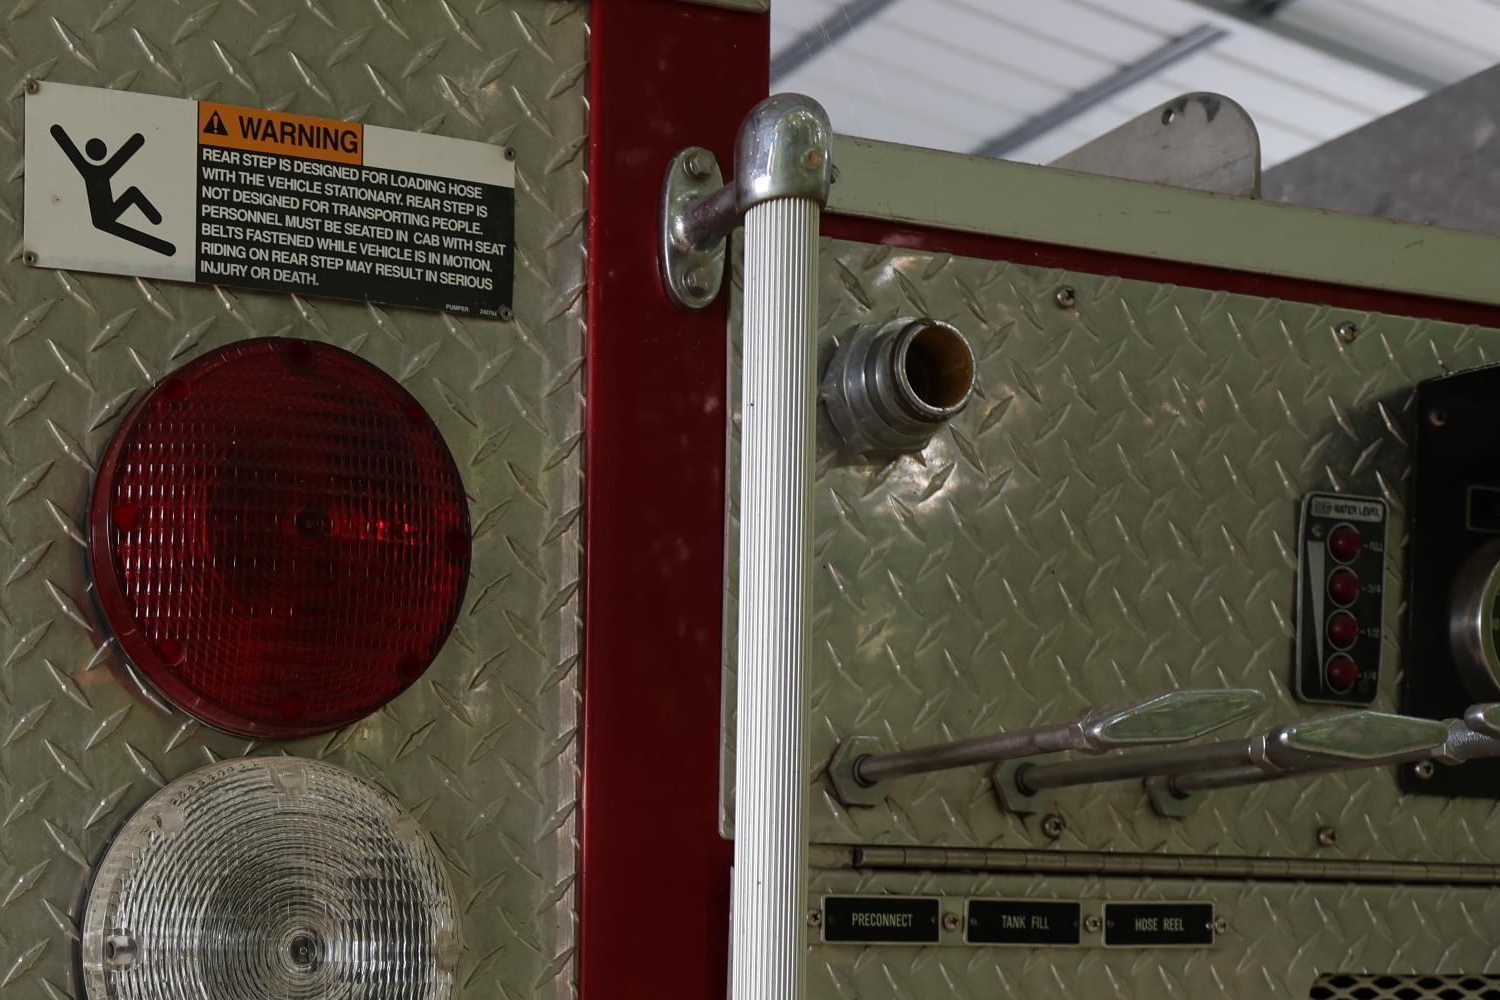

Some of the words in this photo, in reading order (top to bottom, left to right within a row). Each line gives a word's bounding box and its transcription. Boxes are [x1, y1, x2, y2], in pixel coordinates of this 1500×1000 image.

[239, 116, 358, 154] WARNING
[203, 148, 240, 165] REAR
[243, 154, 276, 169] STEP
[279, 159, 292, 172] IS
[294, 160, 359, 181] DESIGNED
[362, 170, 388, 186] FOR
[391, 174, 446, 194] LOADING
[448, 183, 482, 200] HOSE
[202, 166, 236, 182] WITH
[238, 172, 264, 187] THE
[268, 176, 322, 194] VEHICLE
[324, 184, 404, 206] STATIONARY.
[406, 194, 440, 211] REAR
[443, 200, 474, 216] STEP
[476, 205, 488, 218] IS
[202, 186, 233, 200] NOT
[233, 190, 300, 210] DESIGNED
[302, 200, 330, 214] FOR
[332, 202, 430, 228] TRANSPORTING
[432, 216, 484, 235] PEOPLE.
[202, 204, 283, 226] PERSONNEL
[285, 214, 322, 230] MUST
[324, 220, 342, 234] BE
[344, 224, 394, 241] SEATED
[396, 230, 408, 242] IN
[414, 232, 440, 247] CAB
[442, 236, 473, 252] WITH
[475, 240, 506, 256] SEAT
[202, 222, 244, 240] BELTS
[246, 228, 314, 248] FASTENED
[316, 237, 358, 254] WHILE
[360, 242, 412, 262] VEHICLE
[414, 250, 426, 264] IS
[428, 252, 441, 265] IN
[442, 254, 492, 272] MOTION.
[201, 242, 246, 259] RIDING
[249, 248, 269, 262] ON
[272, 250, 308, 267] REAR
[310, 255, 344, 270] STEP
[346, 260, 373, 274] MAY
[376, 264, 424, 281] RESULT
[426, 270, 438, 282] IN
[440, 272, 493, 290] SERIOUS
[201, 260, 248, 278] INJURY
[250, 266, 271, 280] OR
[274, 270, 320, 286] DEATH.
[445, 304, 469, 313] PUMPER
[1334, 504, 1357, 515] WATER
[1359, 506, 1380, 517] LEVEL
[1367, 628, 1380, 638] 1/2
[1364, 670, 1377, 681] 1/4
[852, 912, 912, 928] PRECONNECT
[1002, 914, 1026, 929] TANK
[1031, 916, 1050, 930] FILL
[1134, 917, 1158, 932] HOSE
[1163, 918, 1184, 932] REEL
